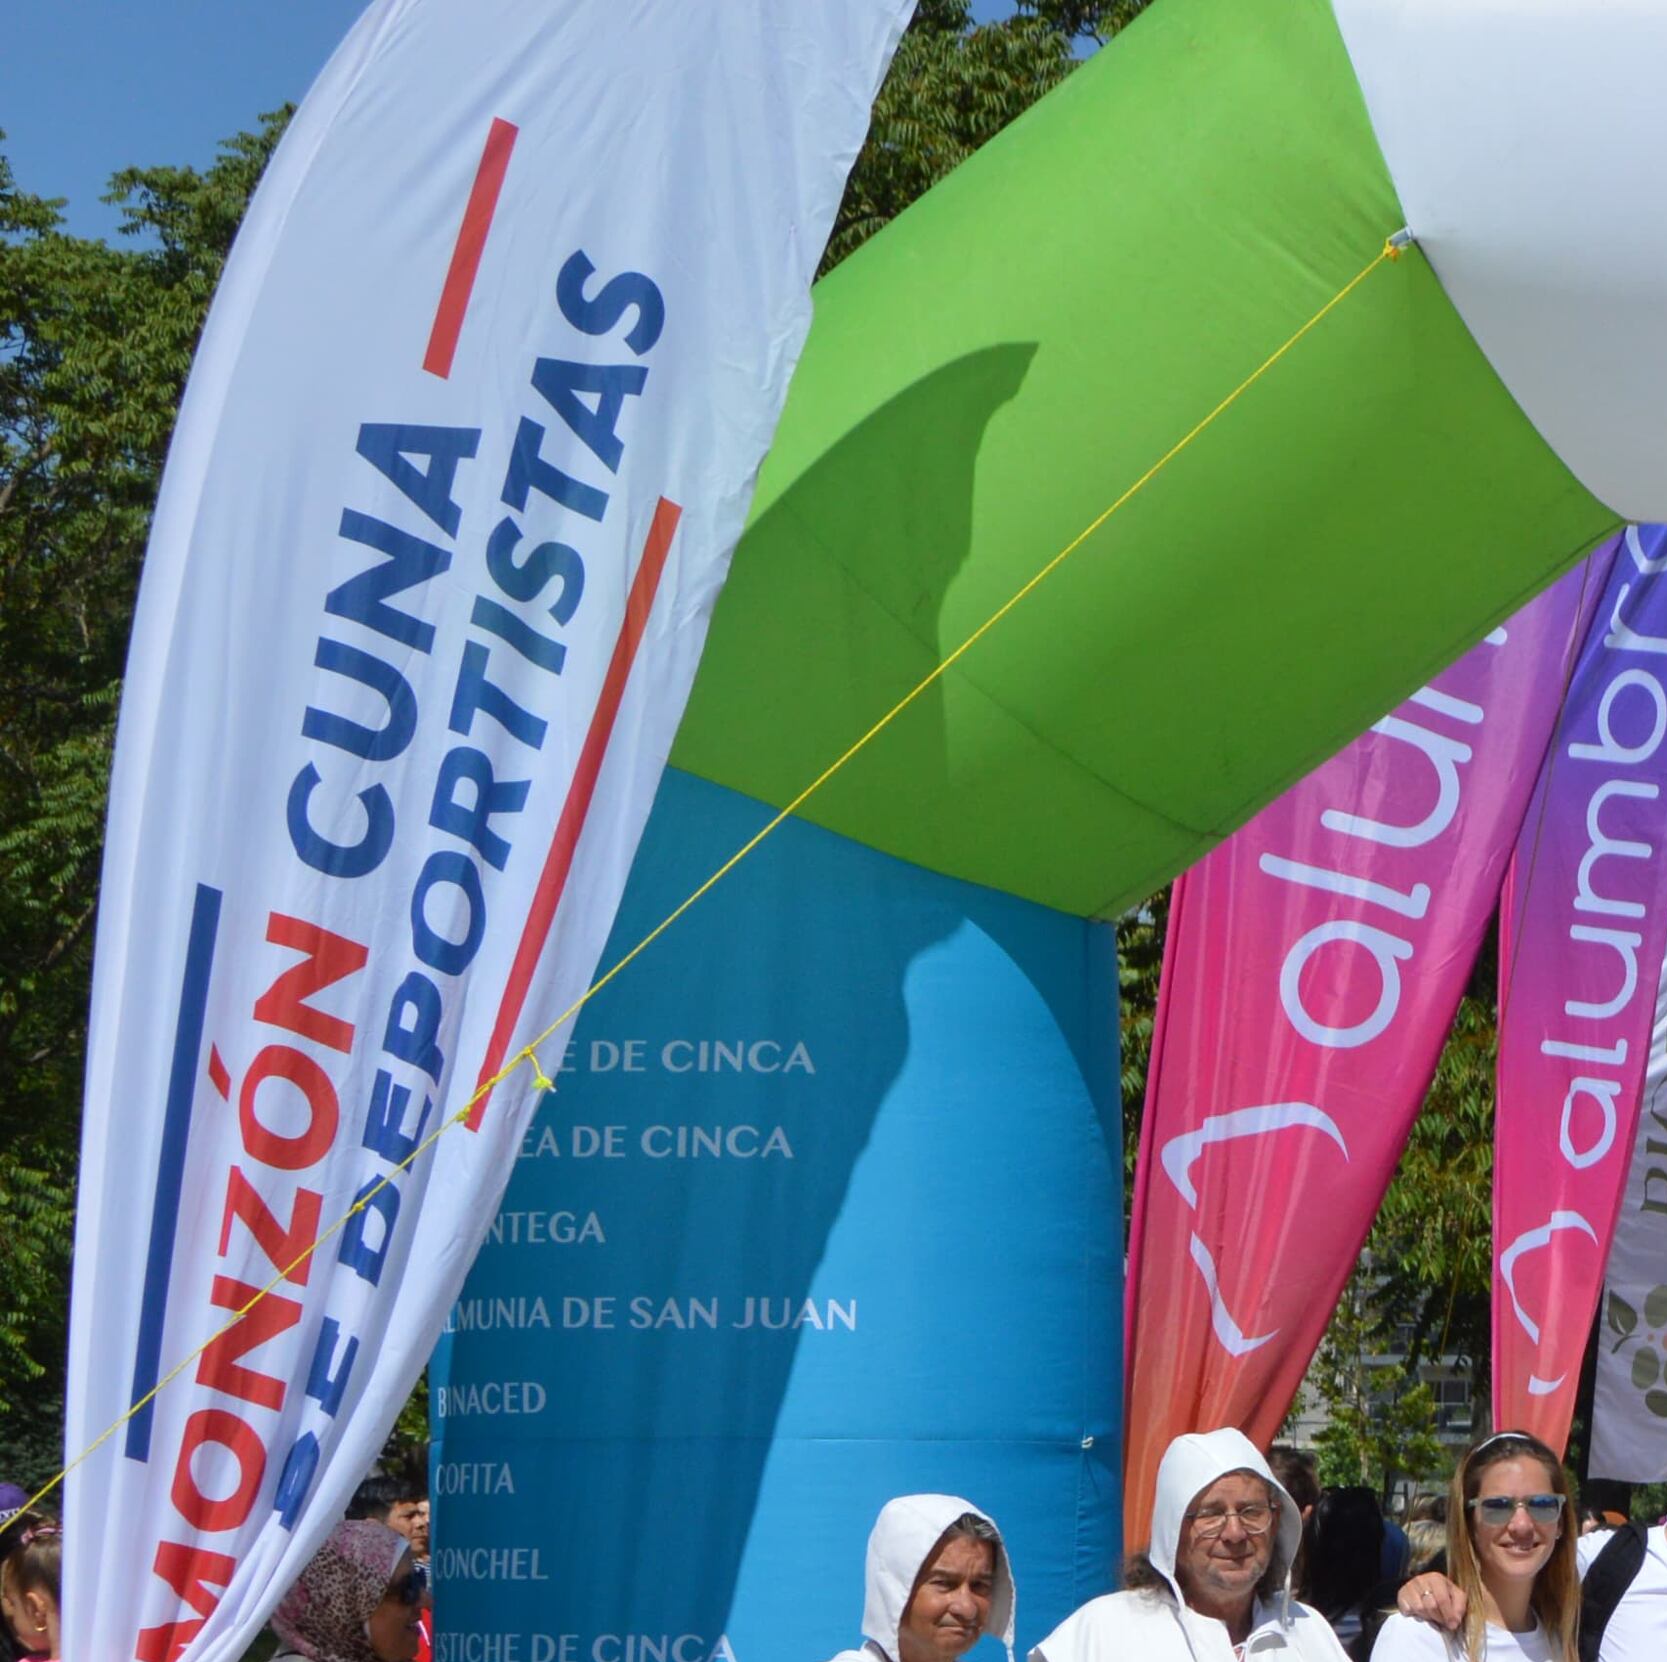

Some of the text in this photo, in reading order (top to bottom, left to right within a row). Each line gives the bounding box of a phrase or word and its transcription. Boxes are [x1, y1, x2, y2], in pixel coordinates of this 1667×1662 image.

[287, 422, 482, 880] CUNA
[340, 249, 667, 1287] DEPORTISTAS
[590, 1040, 647, 1073] DE
[661, 1040, 816, 1074] CINCA
[572, 1125, 626, 1158] DE
[641, 1125, 795, 1159] CINCA
[482, 1211, 606, 1244] NTEGA
[562, 1298, 616, 1329] DE
[629, 1297, 720, 1330] SAN
[732, 1297, 857, 1331] JUAN
[437, 1382, 547, 1418] BINACED
[435, 1463, 516, 1496] COFITA
[434, 1548, 549, 1580] CONCHEL
